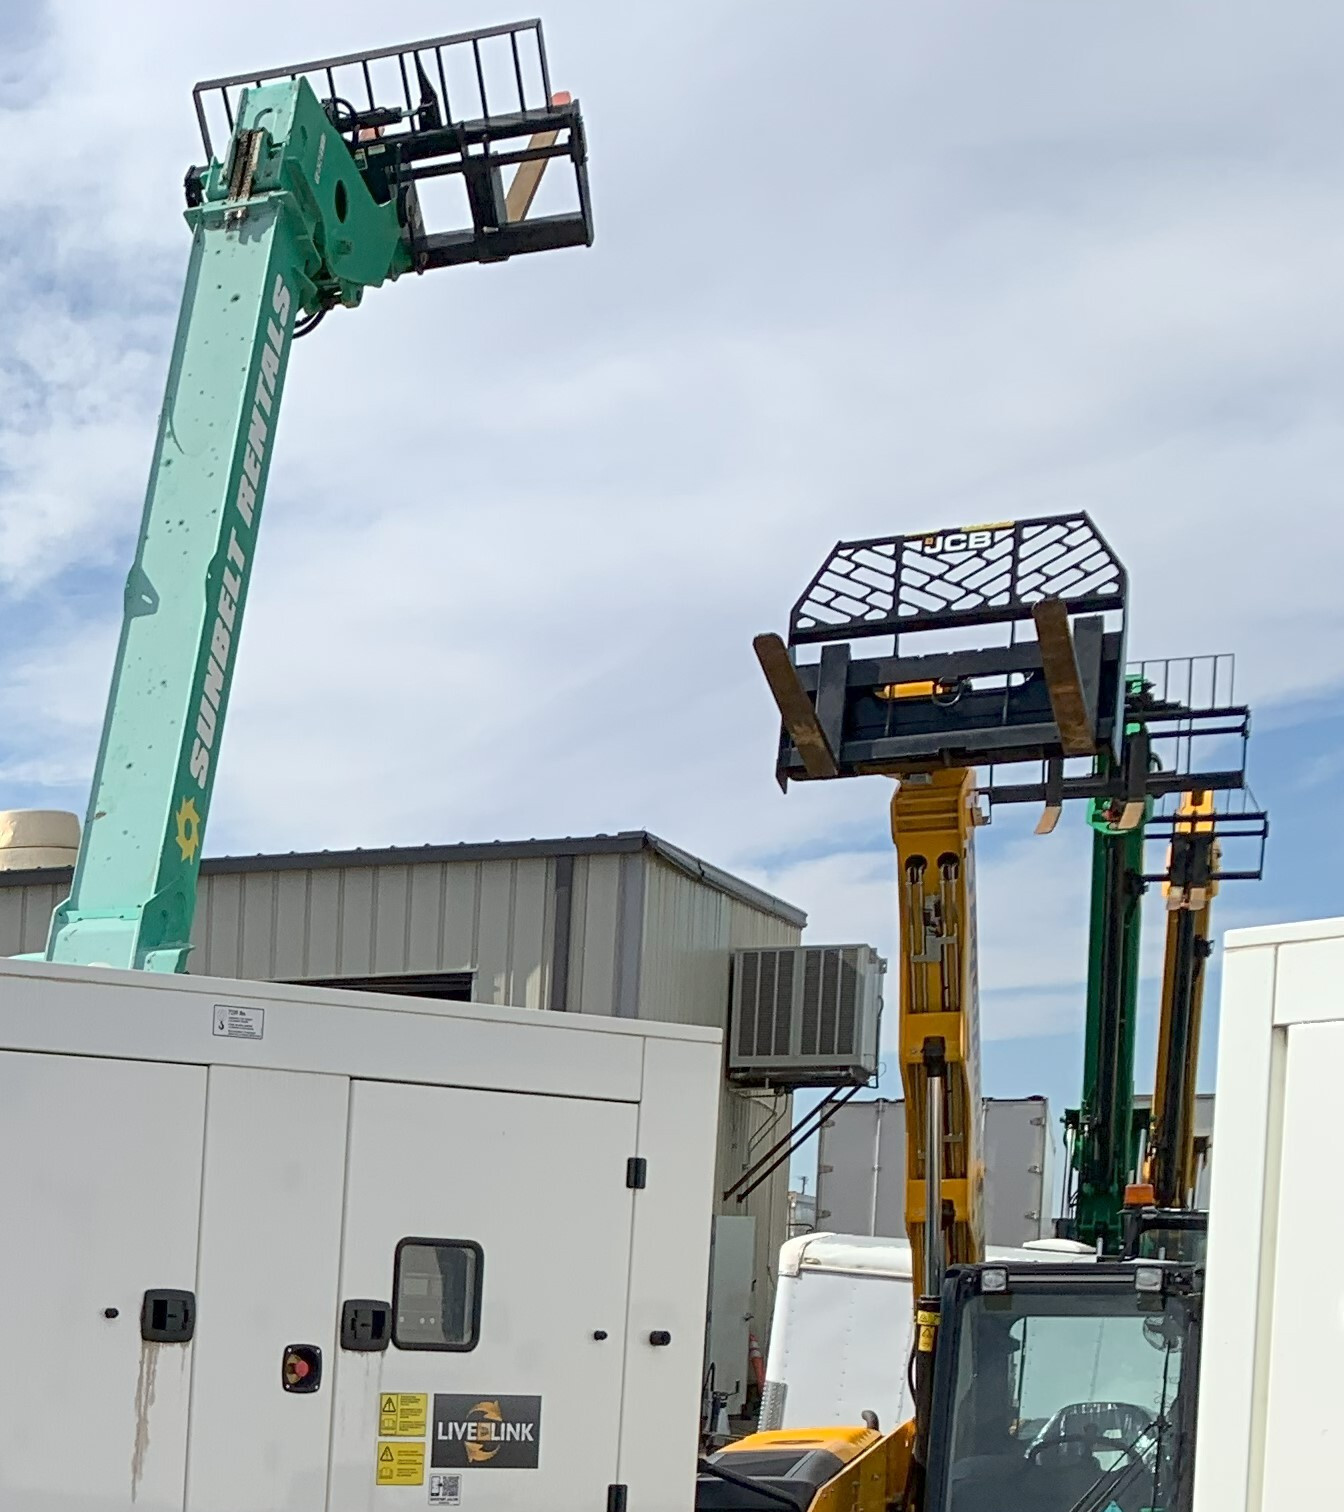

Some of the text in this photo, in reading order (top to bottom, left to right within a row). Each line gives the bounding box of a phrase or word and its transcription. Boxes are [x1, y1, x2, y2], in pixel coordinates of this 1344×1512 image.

[190, 273, 291, 789] SUNBELT RENTALS
[924, 531, 992, 554] JCB
[437, 1421, 534, 1441] LIVE LINK
